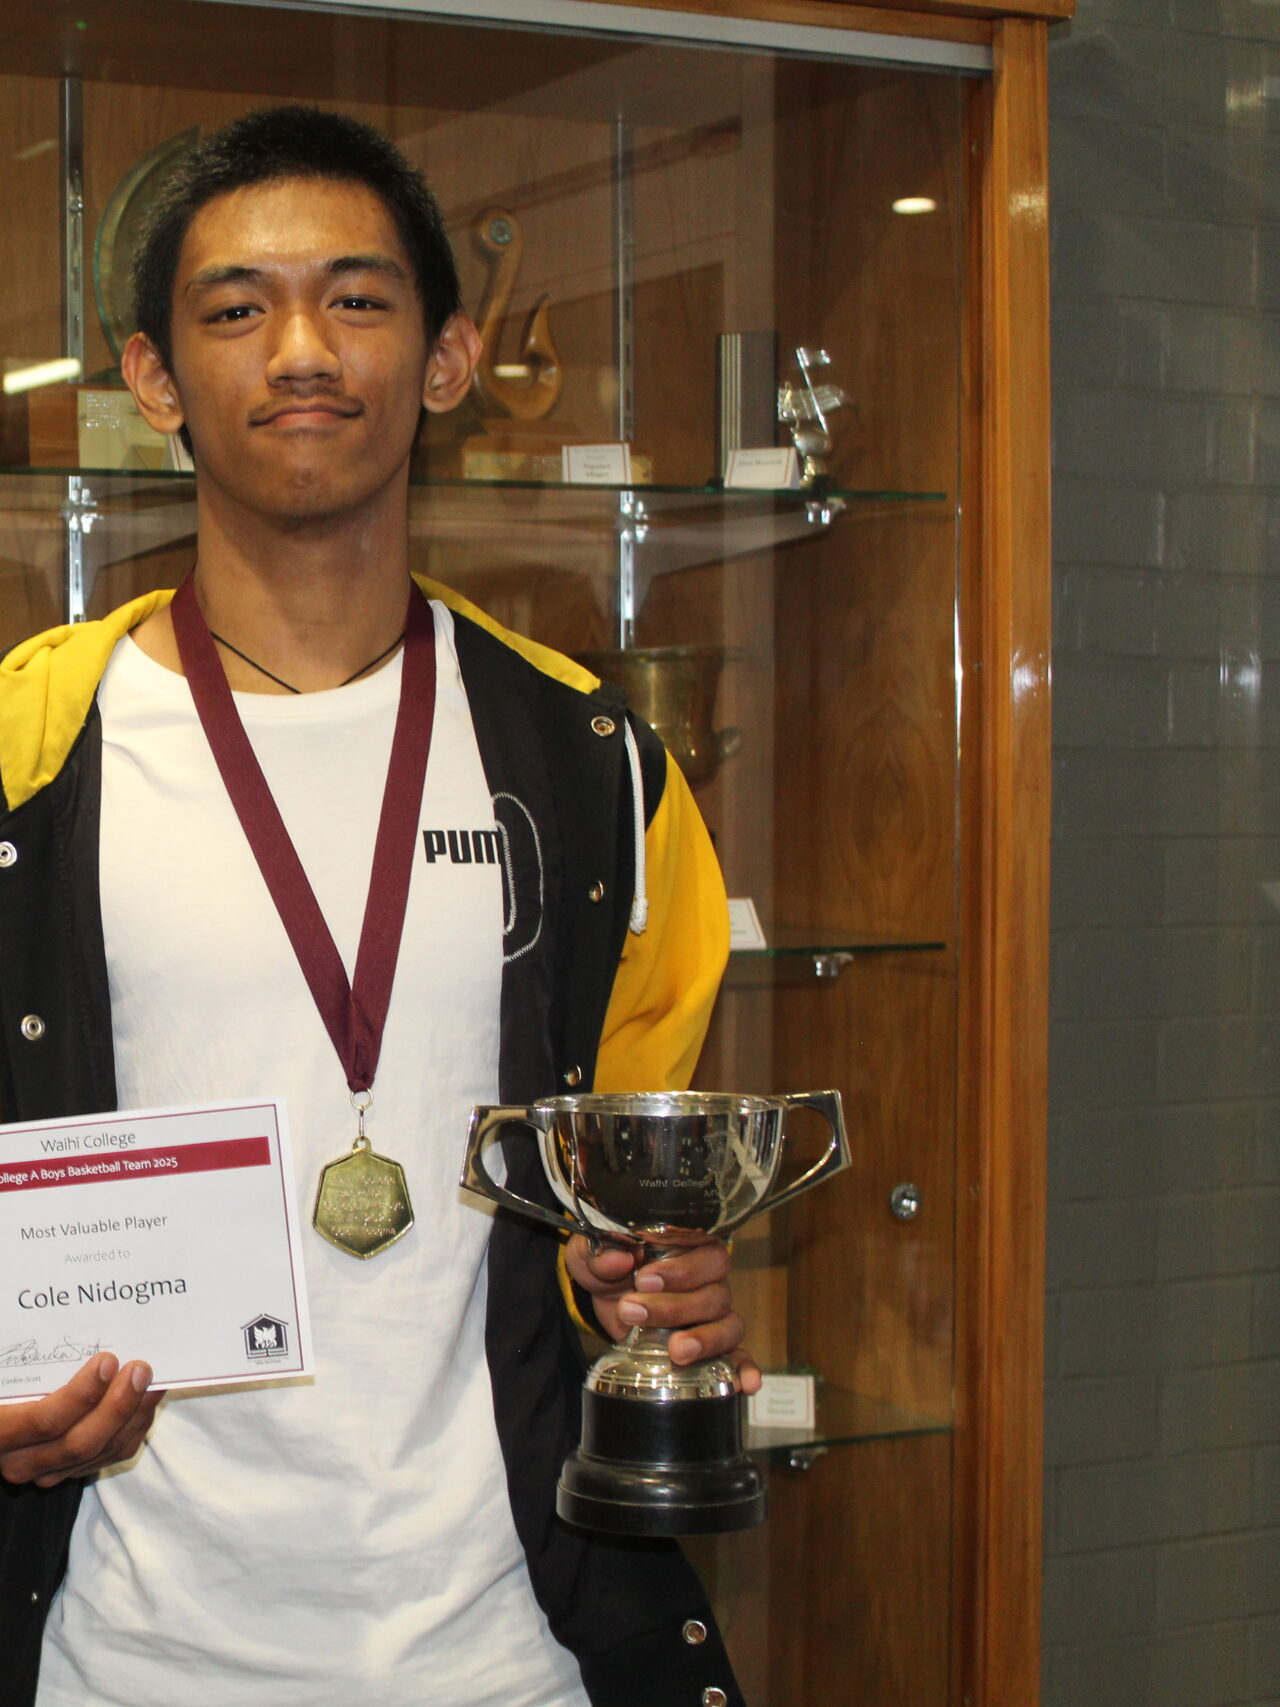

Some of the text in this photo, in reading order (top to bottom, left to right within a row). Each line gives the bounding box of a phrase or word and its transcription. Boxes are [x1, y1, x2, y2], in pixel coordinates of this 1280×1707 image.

[83, 1133, 136, 1149] College
[30, 1170, 39, 1181] A
[41, 1168, 66, 1181] Boys
[68, 1162, 121, 1177] Basketball
[122, 1160, 152, 1171] Team
[153, 1157, 178, 1169] 2025
[20, 1215, 168, 1241] Most Valuable Player
[64, 1249, 131, 1265] Awarded to
[18, 1277, 188, 1310] Cole Nidogma
